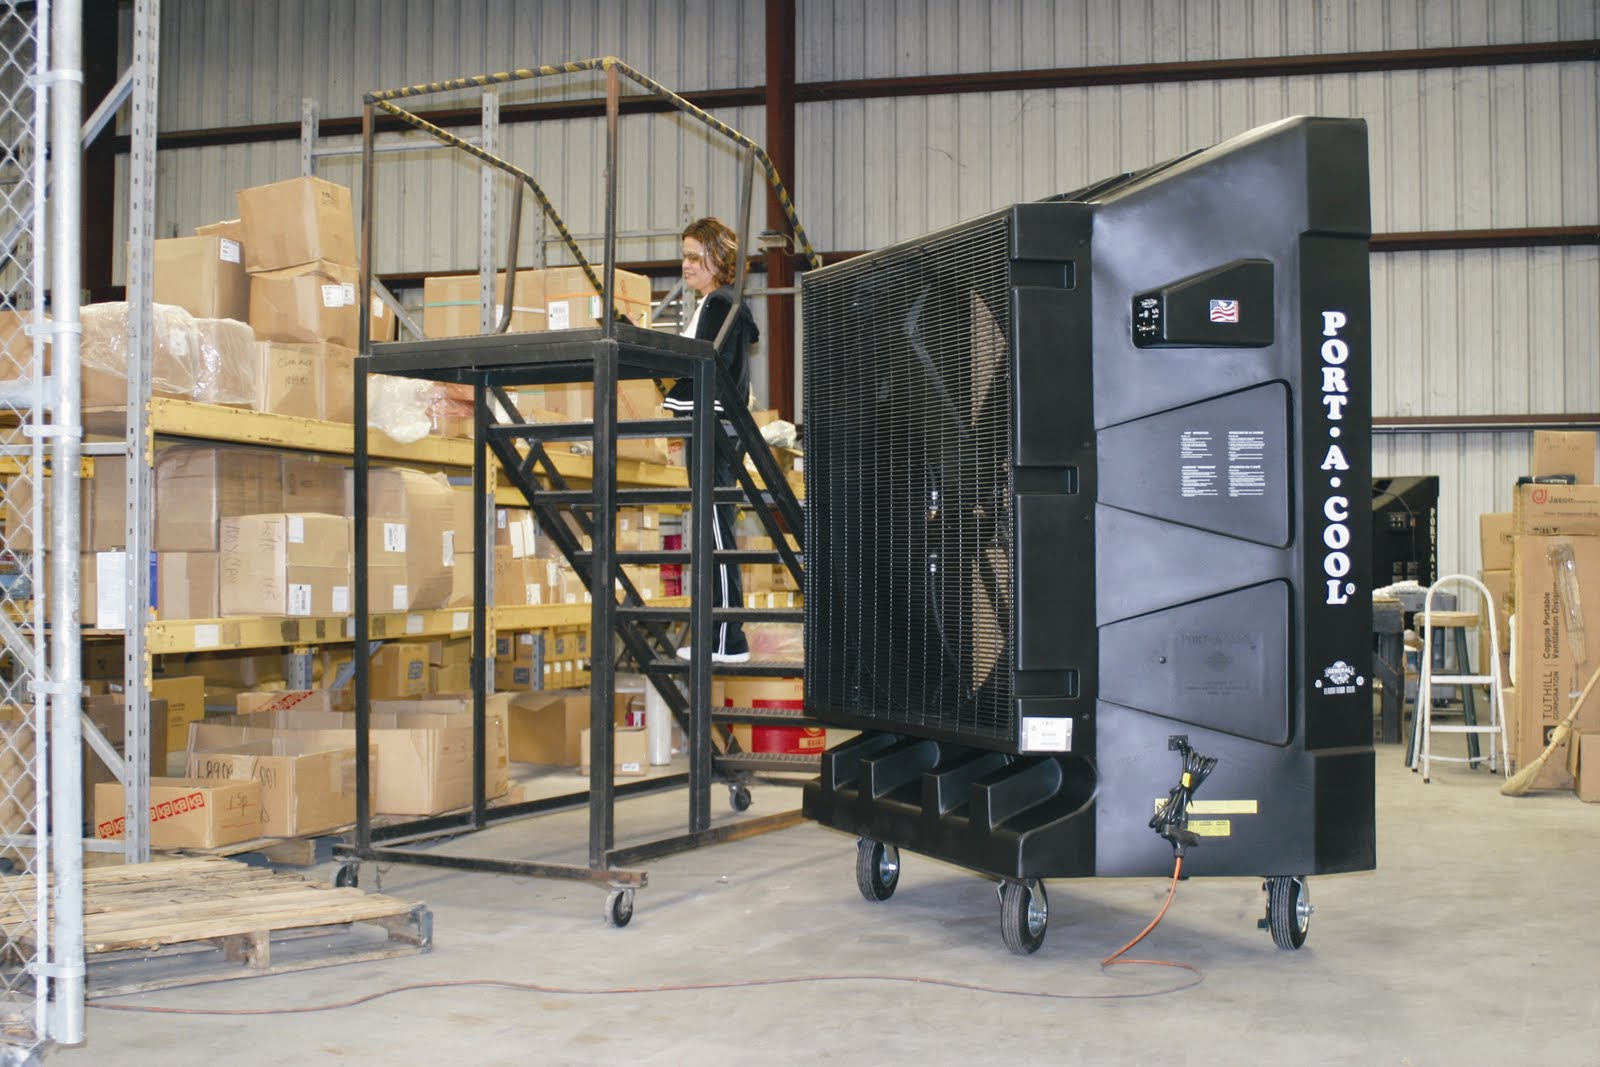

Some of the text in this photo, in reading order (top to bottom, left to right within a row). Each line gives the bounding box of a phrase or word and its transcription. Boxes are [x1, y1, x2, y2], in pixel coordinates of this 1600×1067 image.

[1548, 495, 1574, 504] Jason
[1543, 591, 1551, 626] Portable
[1551, 616, 1560, 660] Ventilation
[1543, 671, 1553, 720] TUTHILL
[1552, 671, 1560, 720] CORPORATION
